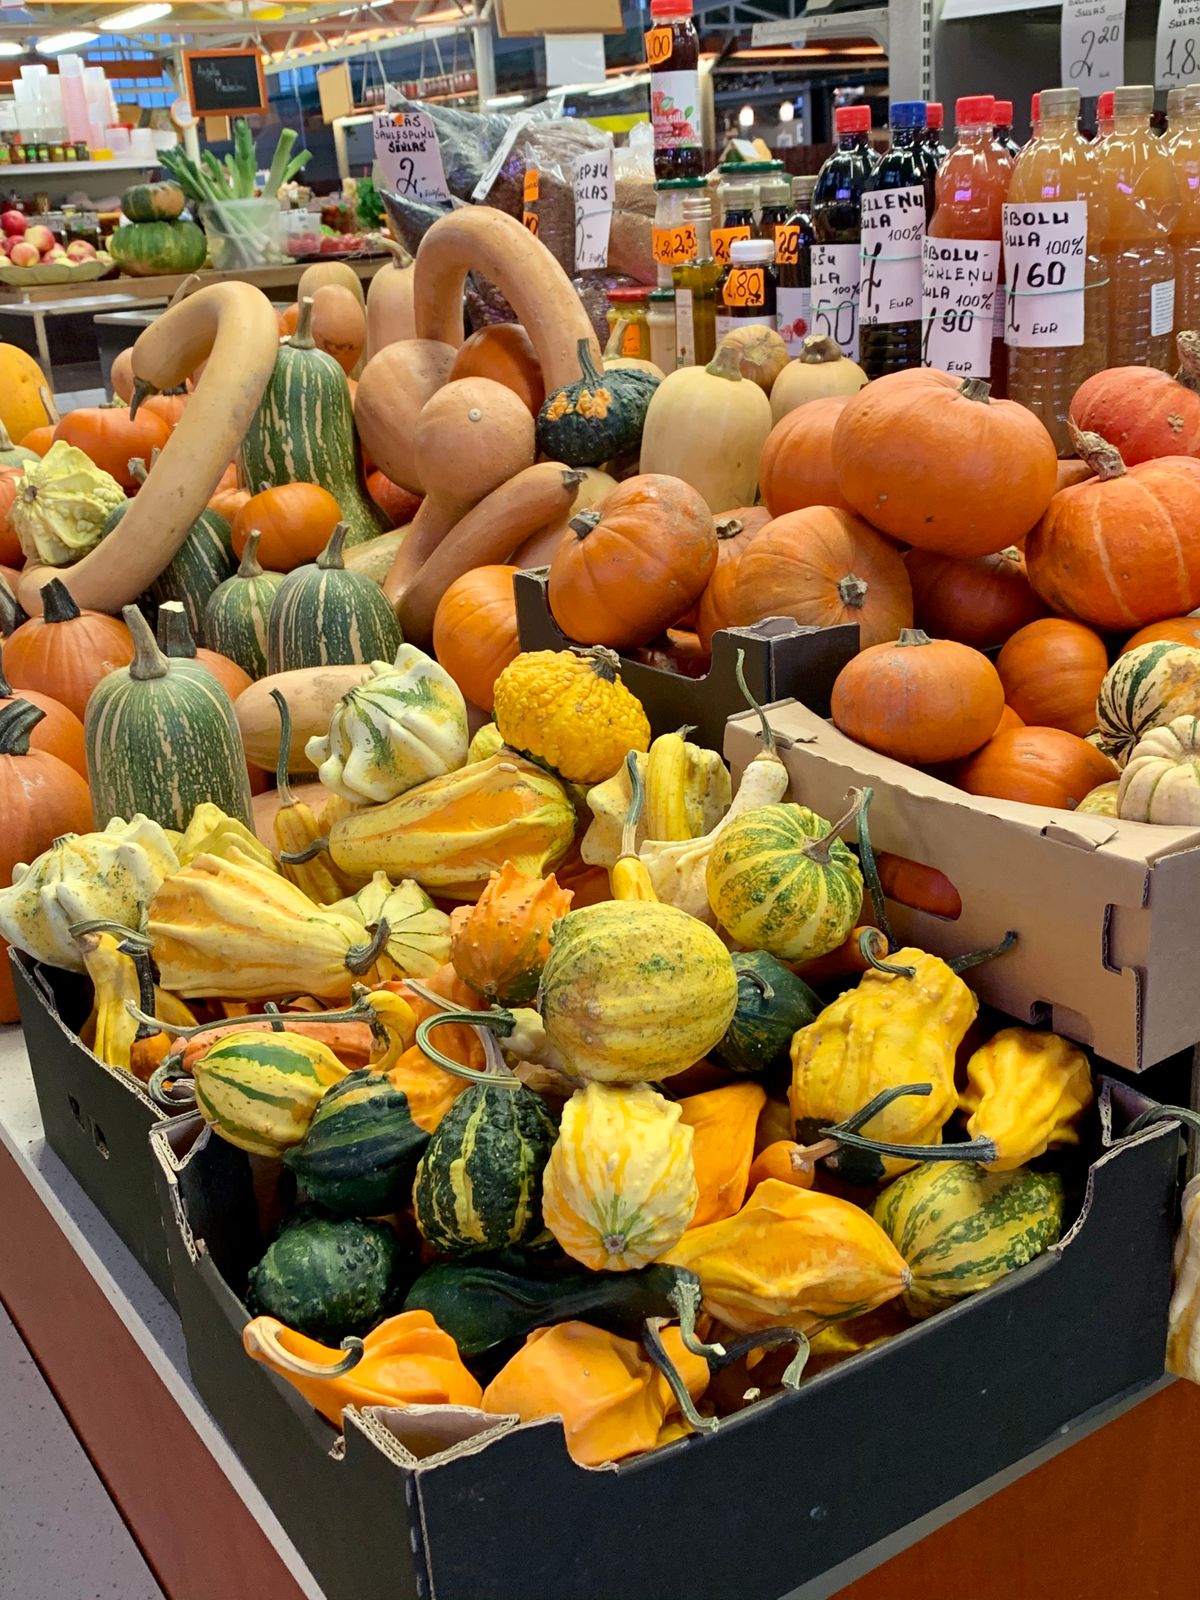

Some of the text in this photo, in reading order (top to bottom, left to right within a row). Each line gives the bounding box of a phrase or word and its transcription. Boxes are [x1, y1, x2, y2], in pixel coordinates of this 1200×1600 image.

[888, 223, 923, 242] 100%
[1045, 236, 1085, 257] 100%
[889, 298, 914, 310] EUR
[955, 292, 994, 310] 100%
[1032, 323, 1059, 335] EUR
[946, 360, 973, 372] EUR
